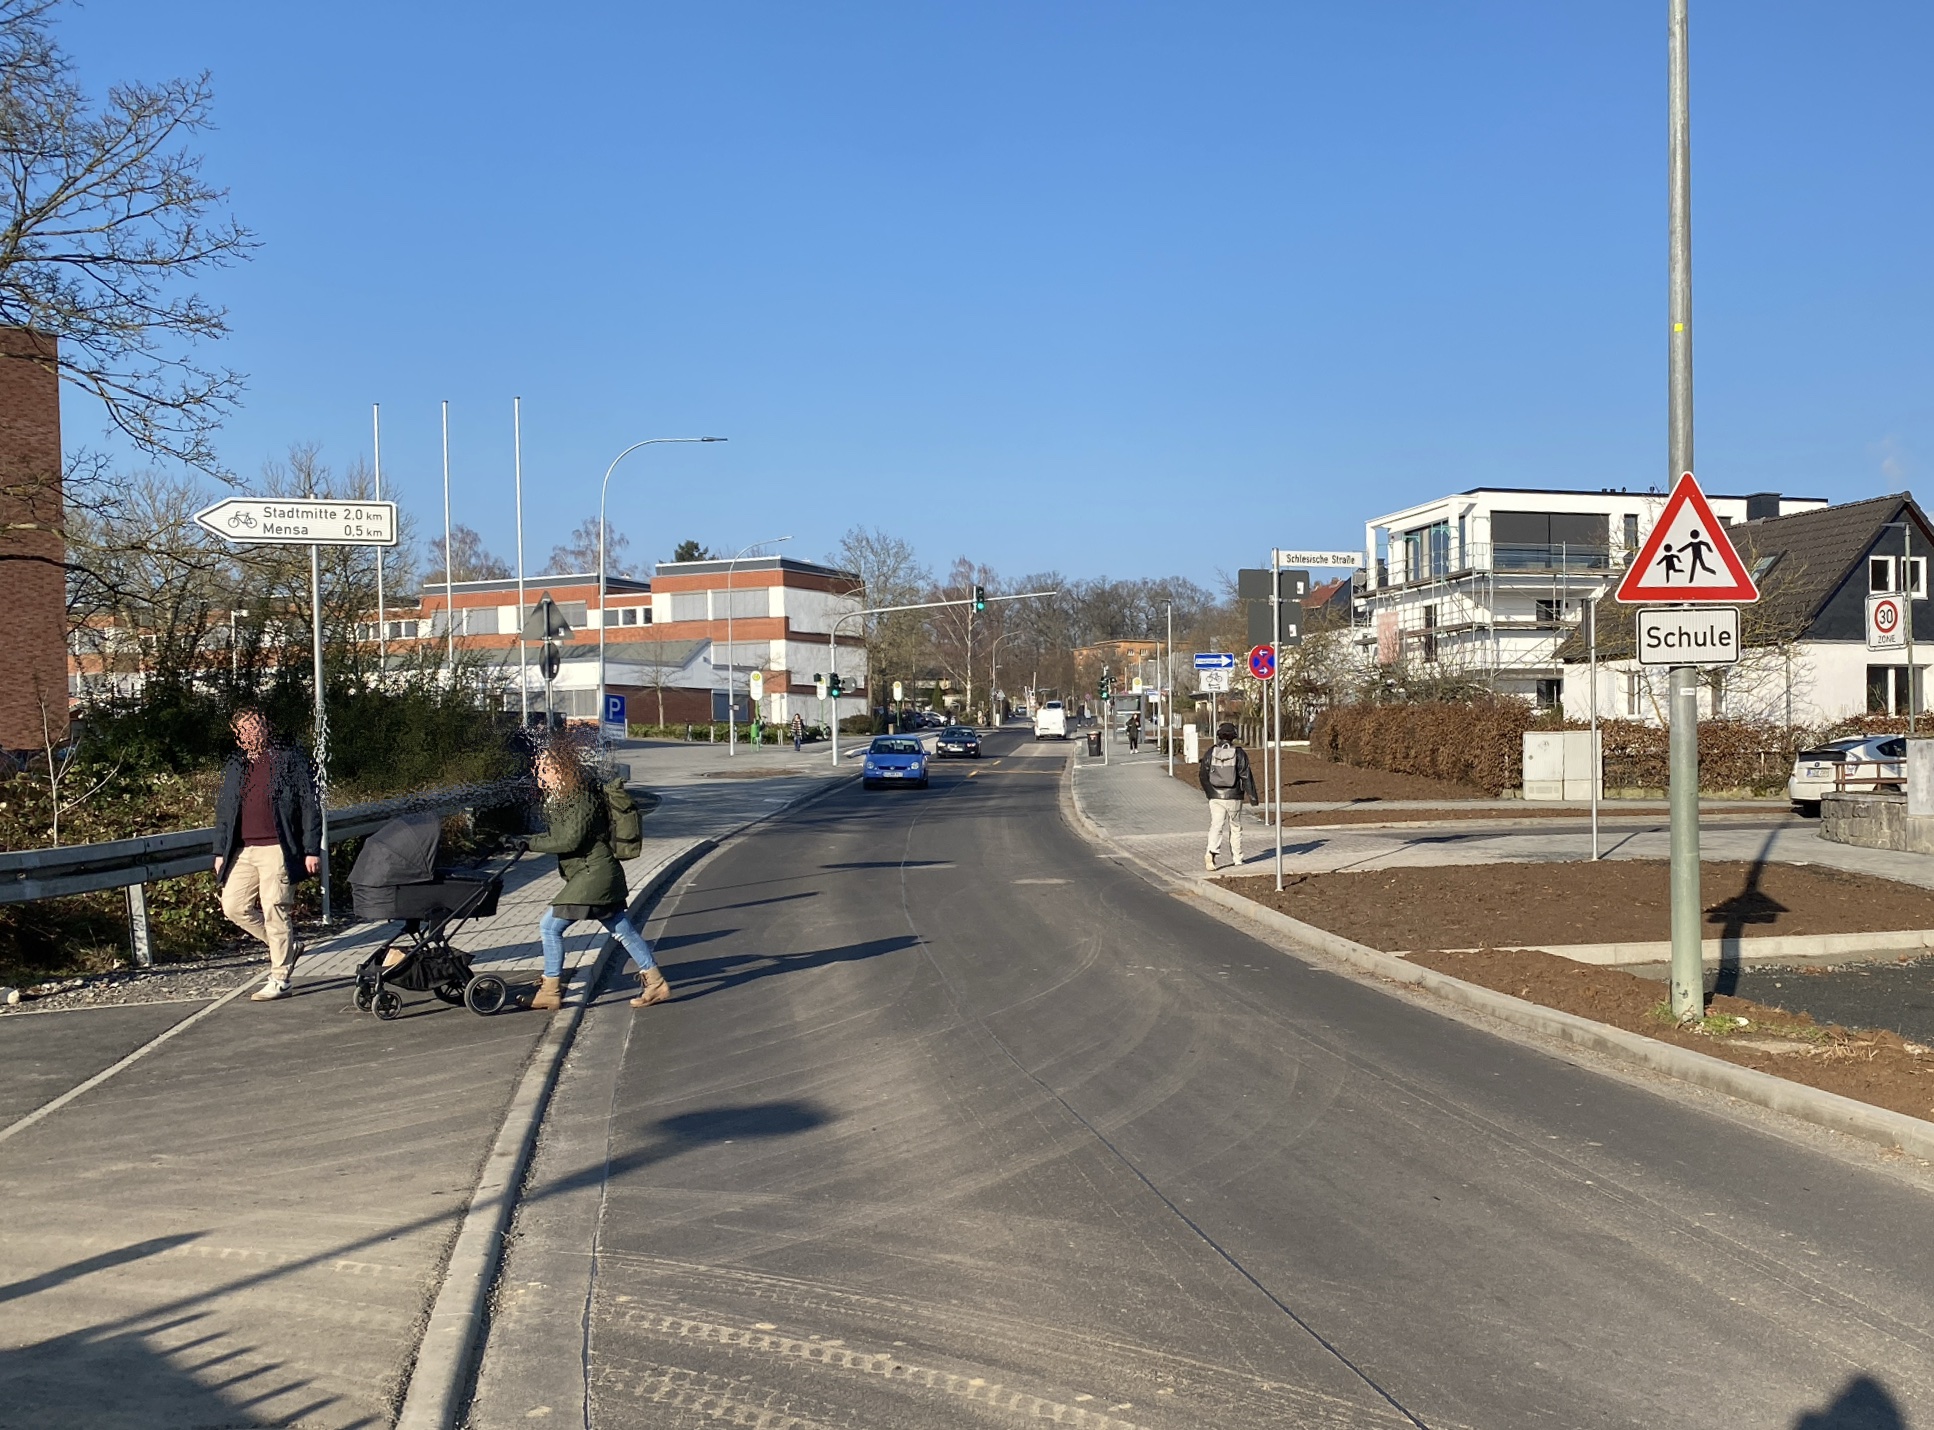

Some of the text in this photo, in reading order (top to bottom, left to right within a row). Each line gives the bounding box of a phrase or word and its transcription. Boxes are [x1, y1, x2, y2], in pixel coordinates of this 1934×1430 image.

[263, 506, 383, 521] Stadtmitte 2,0 km
[262, 523, 383, 537] Mensa 0,5 km
[1286, 553, 1355, 565] Schlesische Straße
[1879, 608, 1894, 625] 30
[1646, 624, 1731, 648] Schule
[1877, 634, 1897, 644] ZONE
[608, 697, 621, 720] P
